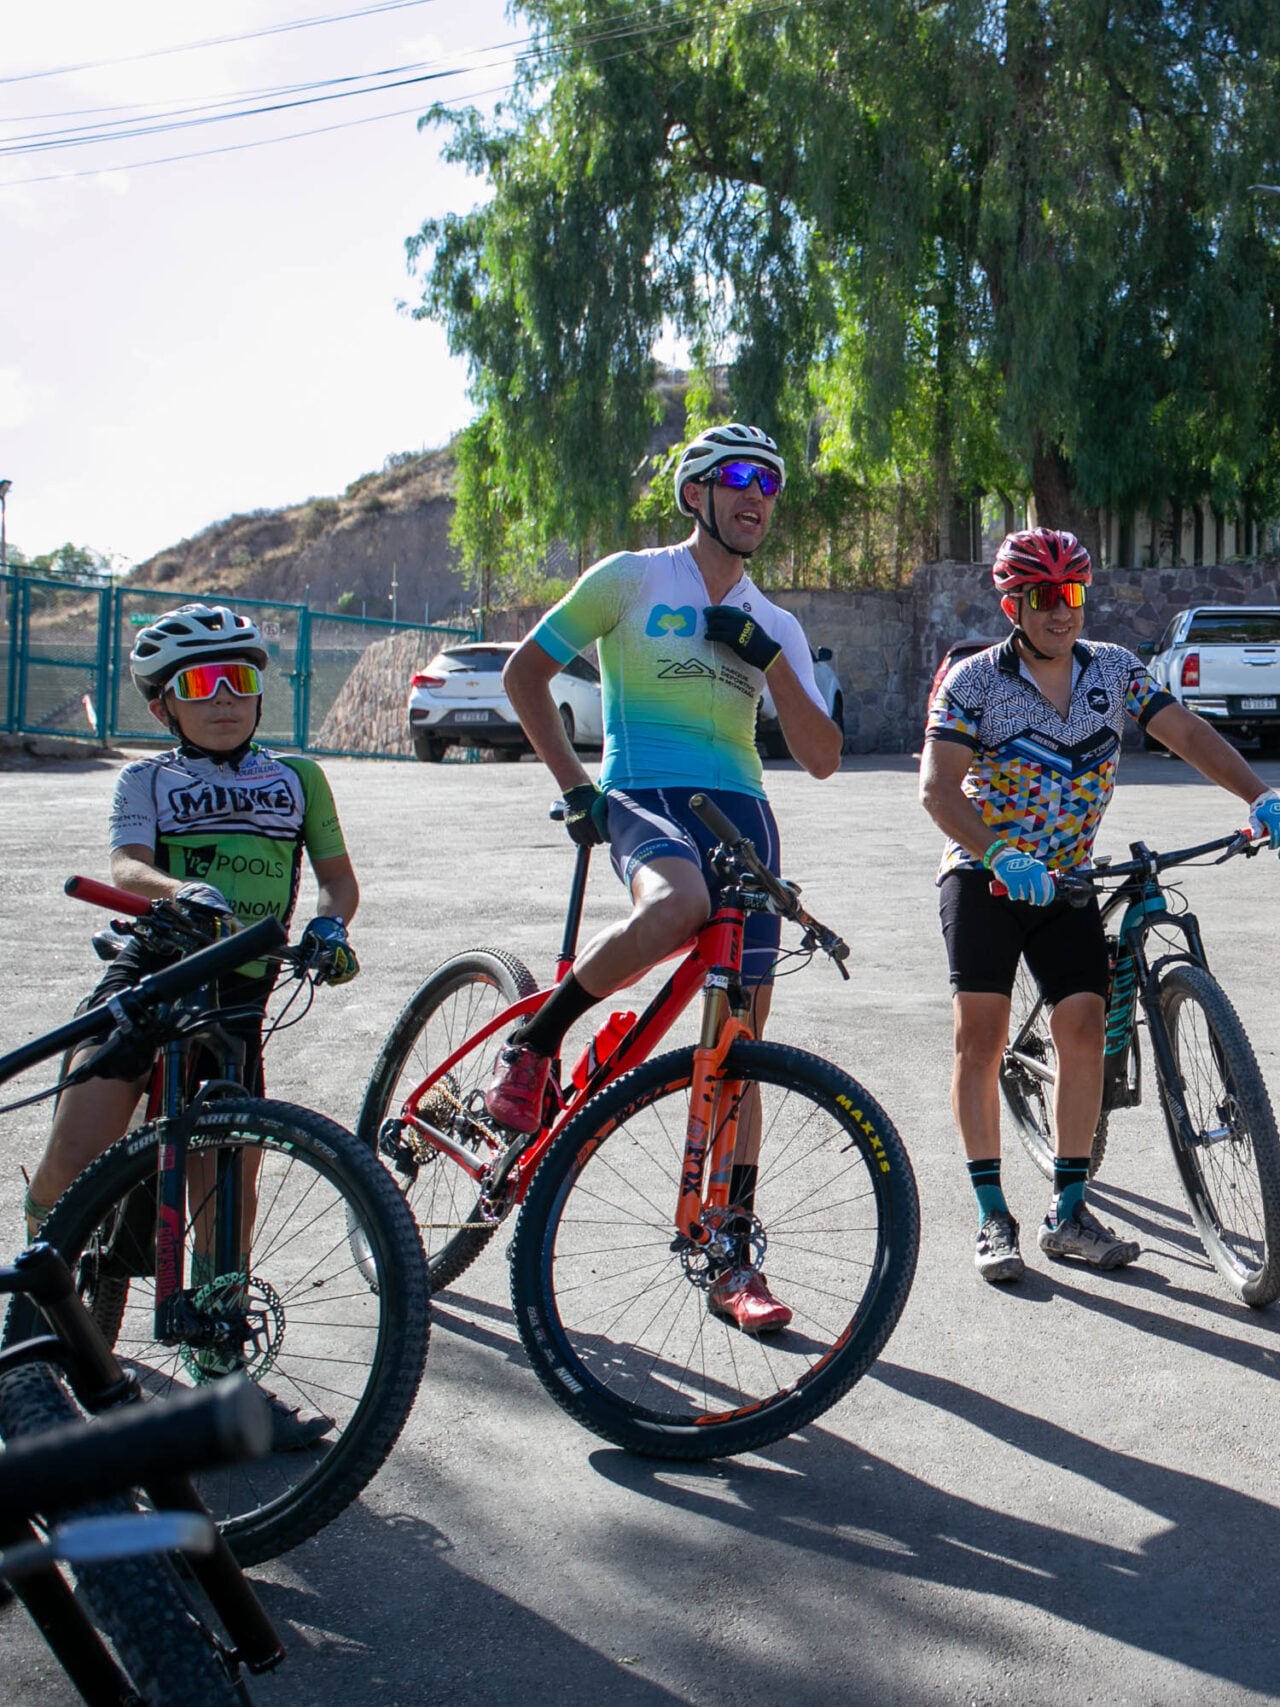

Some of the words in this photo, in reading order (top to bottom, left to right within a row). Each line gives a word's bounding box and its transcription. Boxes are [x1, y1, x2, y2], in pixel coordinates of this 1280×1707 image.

[217, 856, 284, 879] POOLS
[1104, 955, 1135, 1056] CANYON
[835, 1094, 891, 1173] MAXXIS
[682, 1145, 705, 1197] FOX
